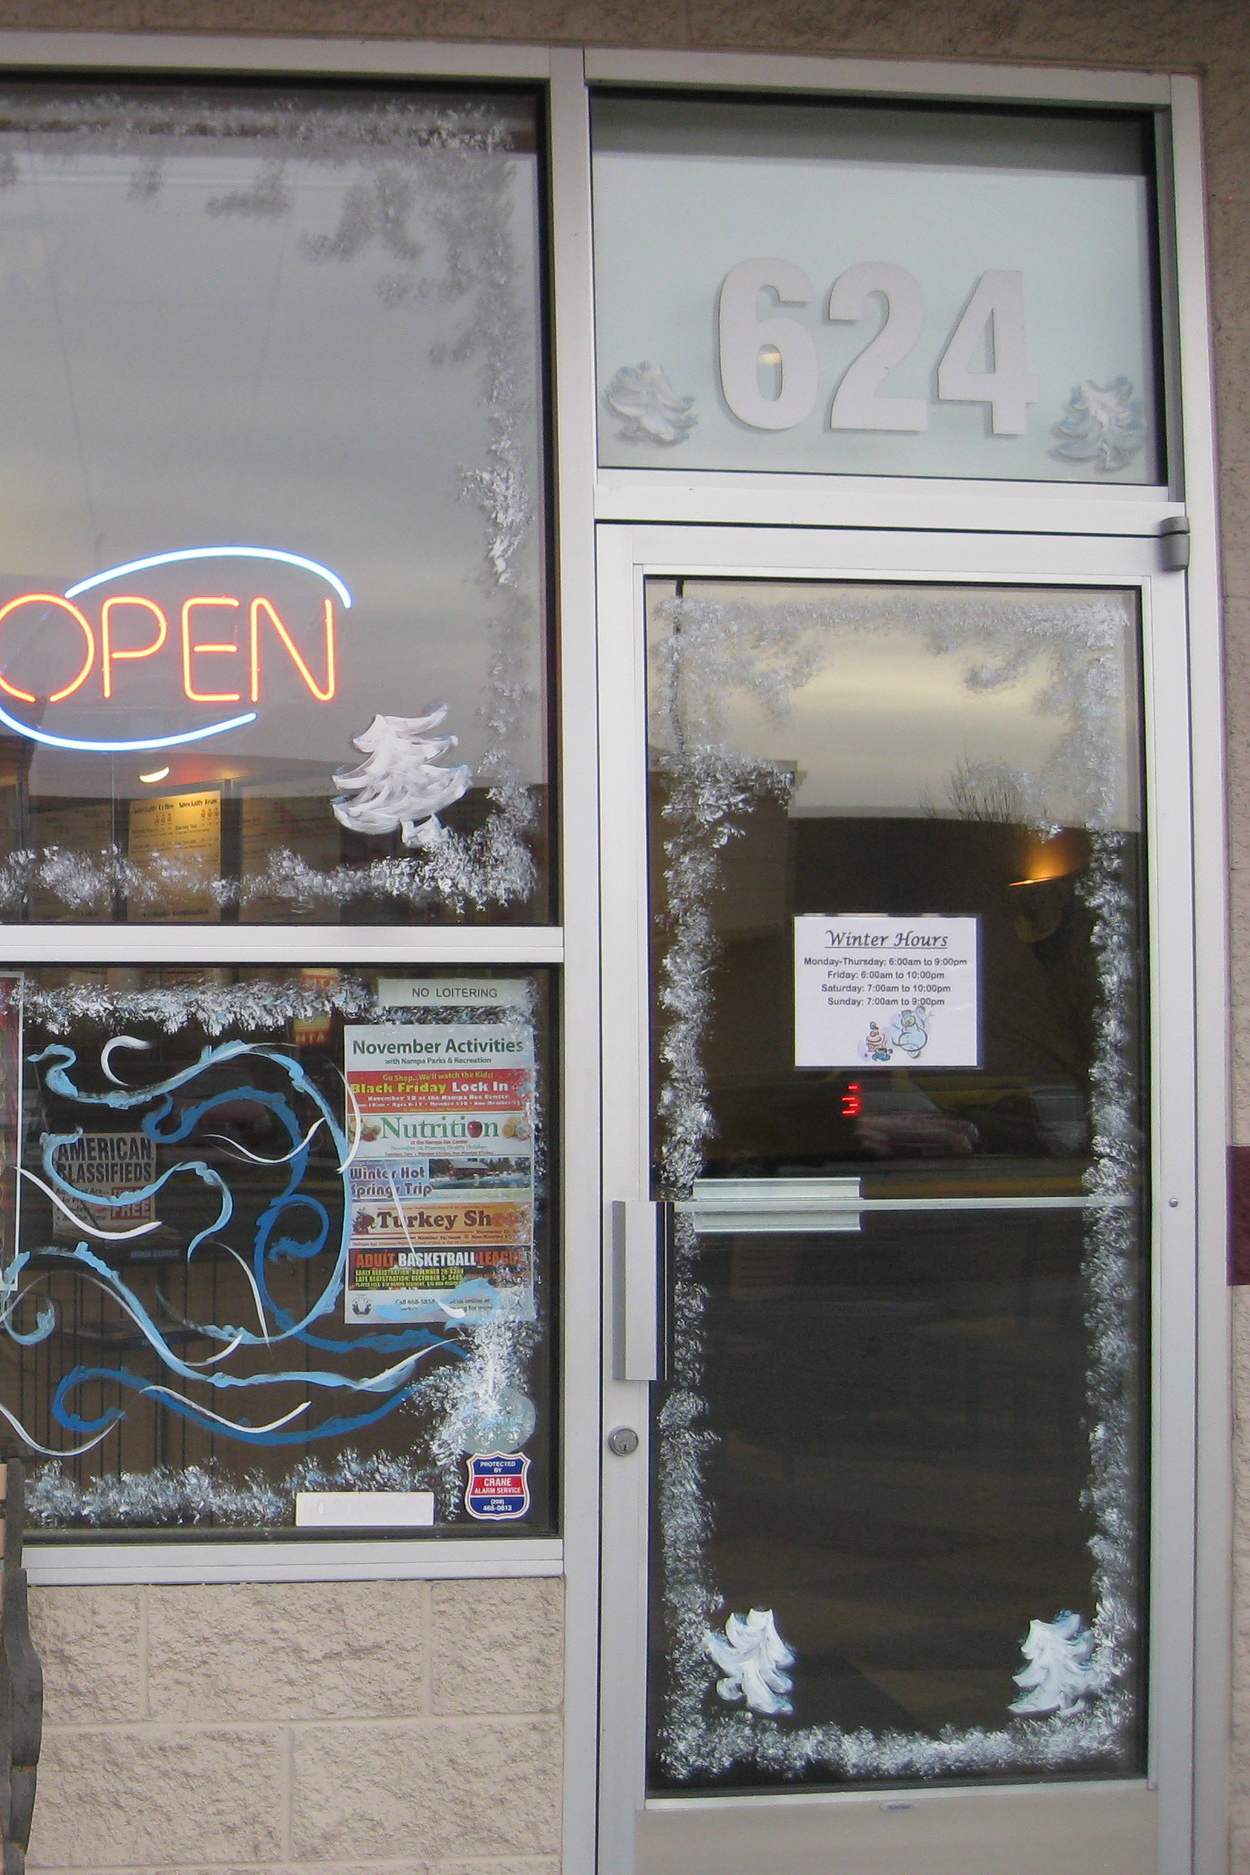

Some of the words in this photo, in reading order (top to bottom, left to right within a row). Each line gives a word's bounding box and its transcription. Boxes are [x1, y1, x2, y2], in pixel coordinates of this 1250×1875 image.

[718, 257, 1040, 435] 624
[825, 930, 889, 947] Winter
[893, 930, 948, 947] Hours
[803, 957, 887, 966] Monday-Thursday:
[889, 957, 922, 966] 6:00am
[924, 958, 933, 966] to
[934, 958, 967, 967] 9:00pm
[827, 971, 859, 980] Friday:
[861, 971, 893, 979] 6:00am
[895, 971, 904, 979] to
[907, 971, 945, 980] 10:00pm
[412, 988, 430, 998] NO
[435, 988, 498, 998] LOITERING
[821, 984, 865, 993] Saturday:
[867, 984, 899, 992] 7:00am
[901, 984, 910, 992] to
[913, 984, 951, 993] 10:00pm
[827, 997, 865, 1007] Sunday:
[867, 998, 899, 1006] 7:00am
[901, 998, 910, 1006] to
[911, 998, 945, 1007] 9:00pm
[352, 1039, 442, 1055] November
[445, 1038, 524, 1053] Activities
[401, 1058, 425, 1066] Nampa
[454, 1056, 492, 1064] Recreation
[438, 1072, 460, 1080] watch
[351, 1082, 393, 1094] Black
[398, 1082, 447, 1095] Friday
[452, 1081, 489, 1092] Lock
[493, 1081, 509, 1092] In
[380, 1116, 500, 1139] Nutrition
[57, 1137, 151, 1161] AMERICAN
[350, 1166, 397, 1180] Winter
[400, 1166, 426, 1179] Hot
[404, 1182, 433, 1198] Trip
[377, 1211, 458, 1231] Turkey
[356, 1252, 396, 1268] ADULT
[398, 1251, 477, 1267] BASKETBALL
[478, 1250, 527, 1266] LEAGU
[483, 1478, 512, 1487] CRANE
